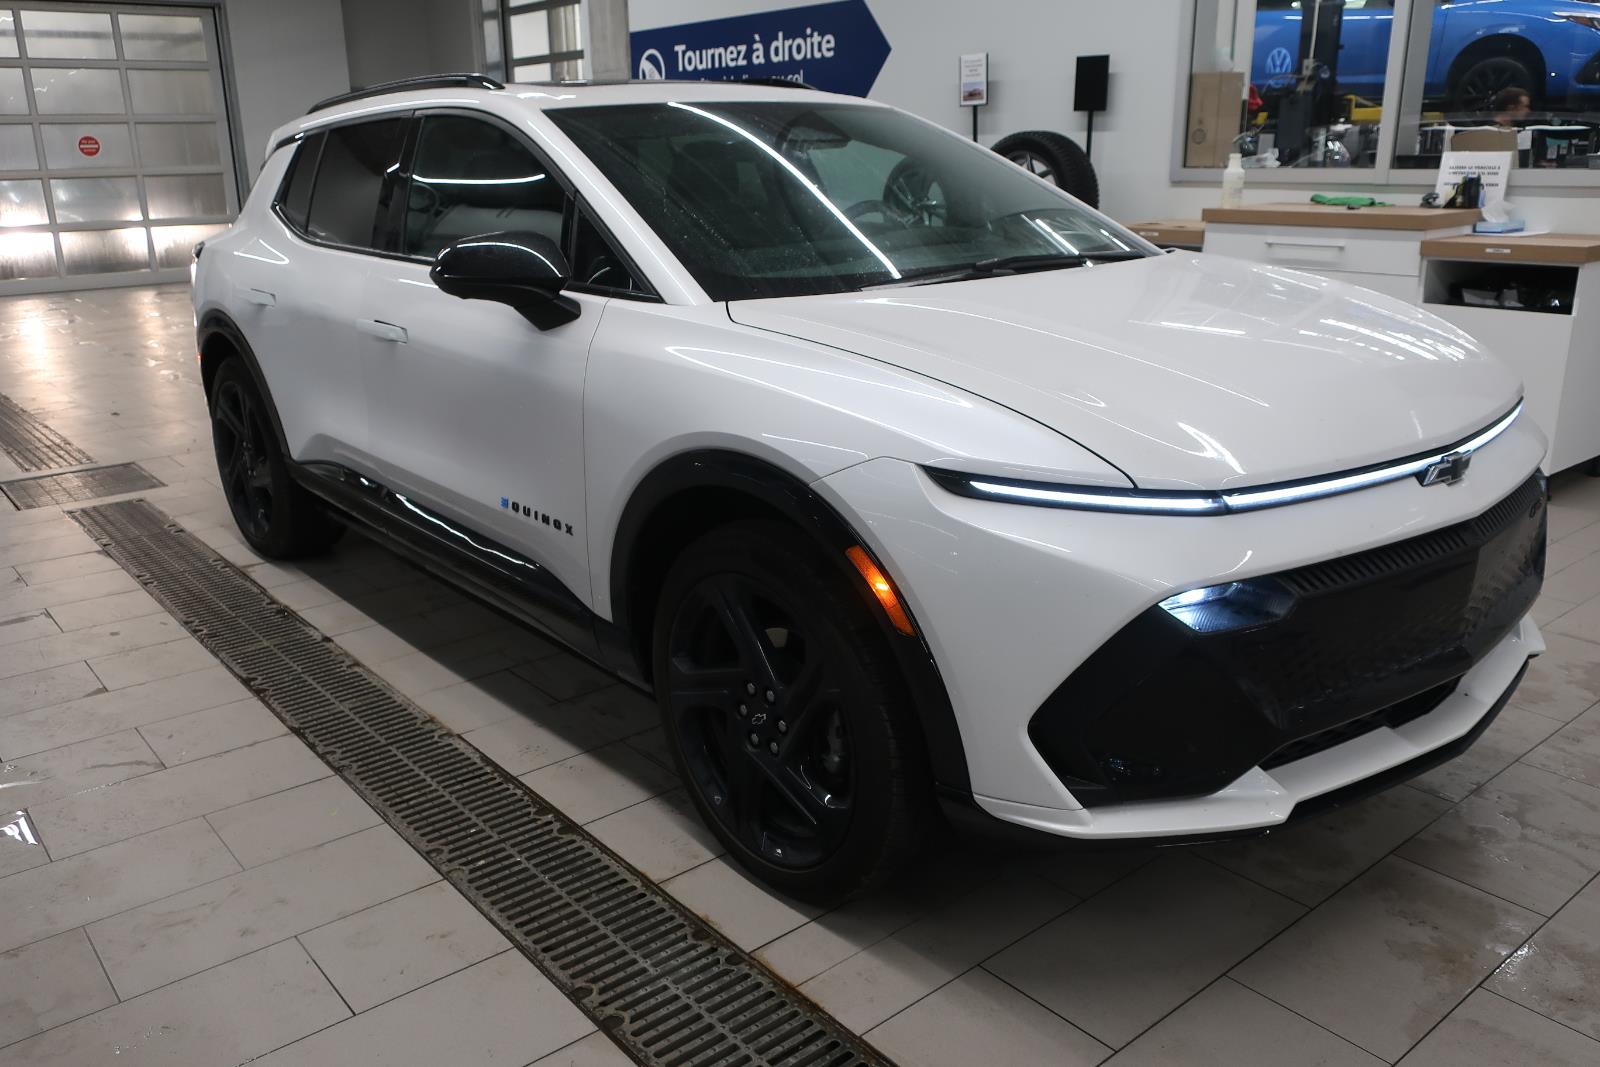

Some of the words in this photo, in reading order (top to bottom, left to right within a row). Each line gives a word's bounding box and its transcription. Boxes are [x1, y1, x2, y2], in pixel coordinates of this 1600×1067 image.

[674, 44, 747, 72] Tournez
[752, 33, 765, 65] à
[770, 27, 835, 63] droite
